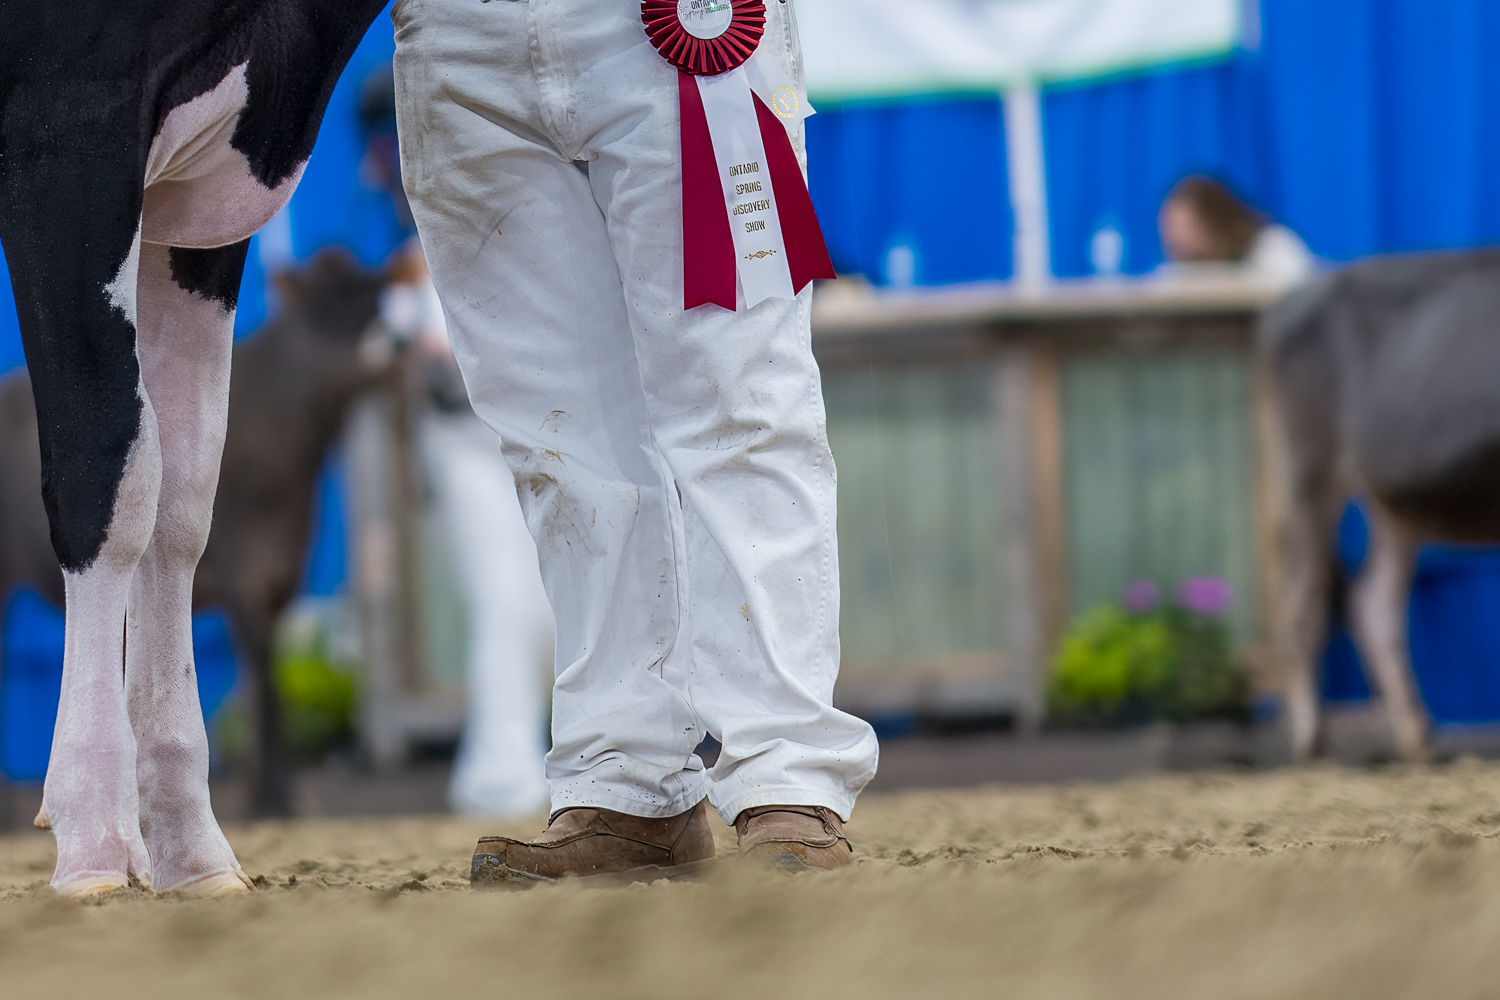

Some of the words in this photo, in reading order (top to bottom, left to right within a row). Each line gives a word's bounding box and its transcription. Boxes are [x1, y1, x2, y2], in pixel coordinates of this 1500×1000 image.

[729, 161, 760, 177] ONTARIO
[735, 181, 762, 195] SPRING
[732, 199, 770, 216] DISCOVERY
[745, 220, 766, 233] SHOW
